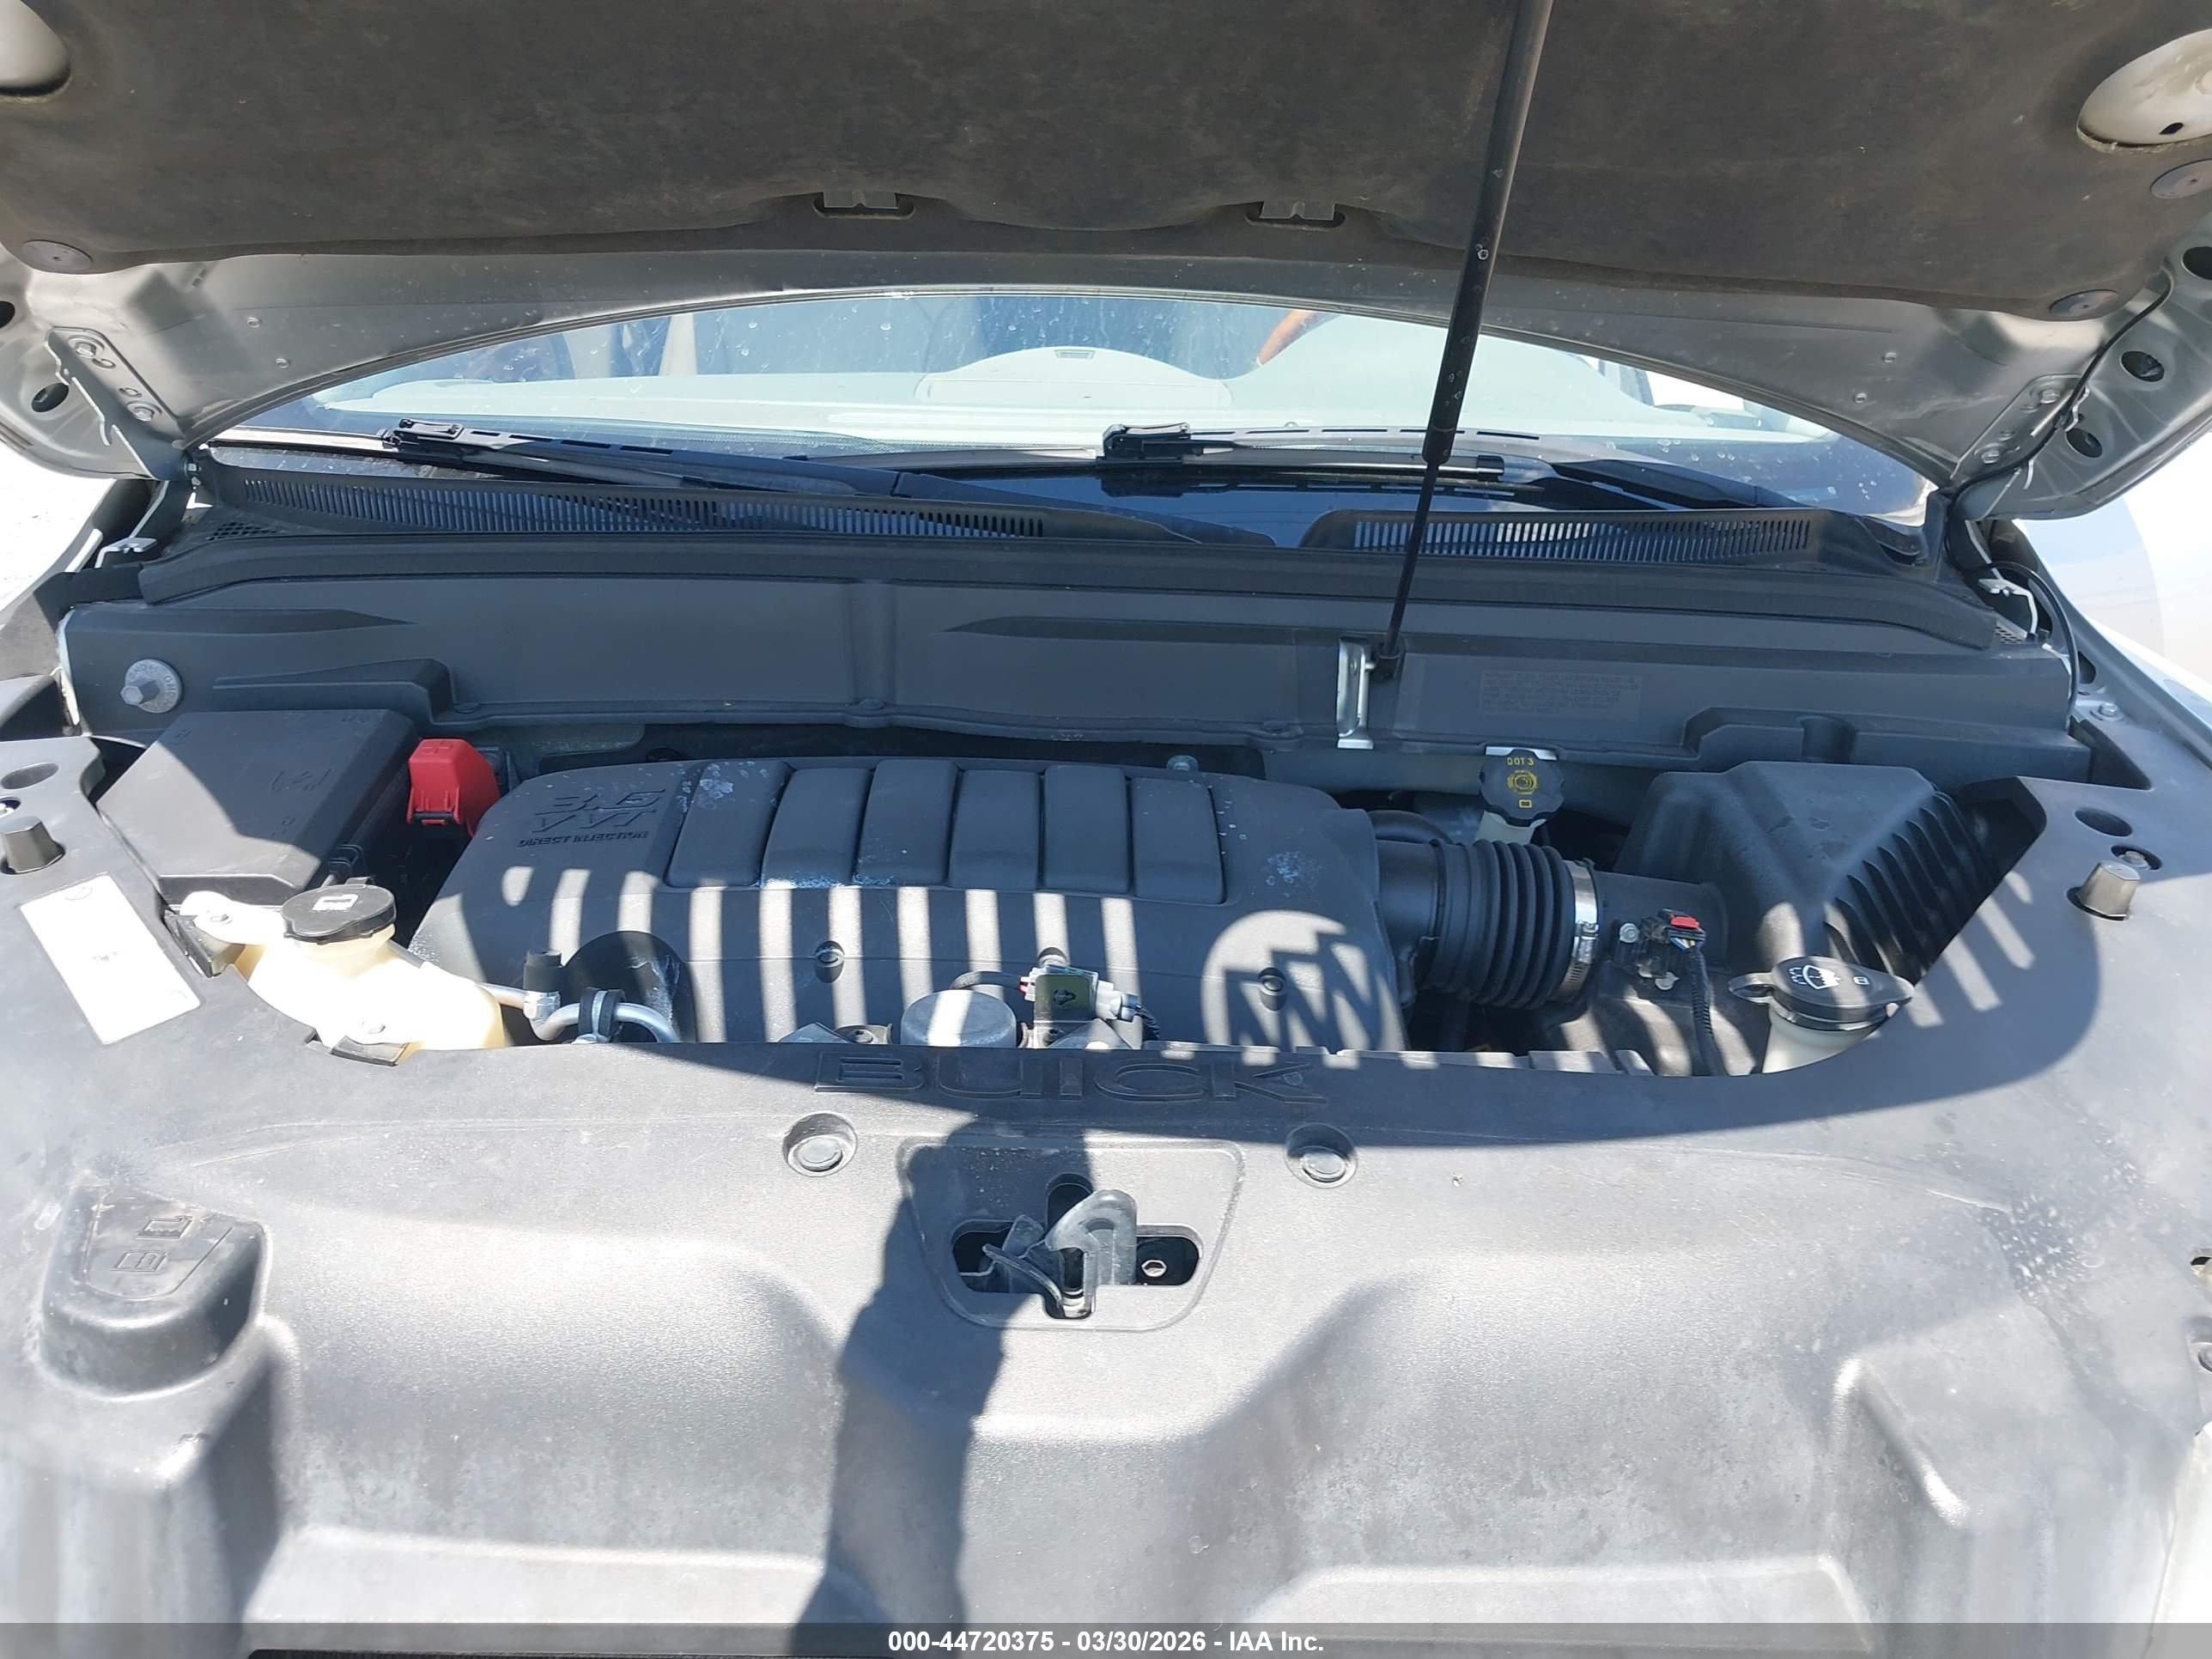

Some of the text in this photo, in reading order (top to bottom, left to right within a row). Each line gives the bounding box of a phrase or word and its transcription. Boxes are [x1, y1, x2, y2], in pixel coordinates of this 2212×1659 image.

[1507, 757, 1534, 766] DOT 3
[516, 831, 648, 848] DIRECT INJECTION
[813, 1050, 1327, 1104] BUICK
